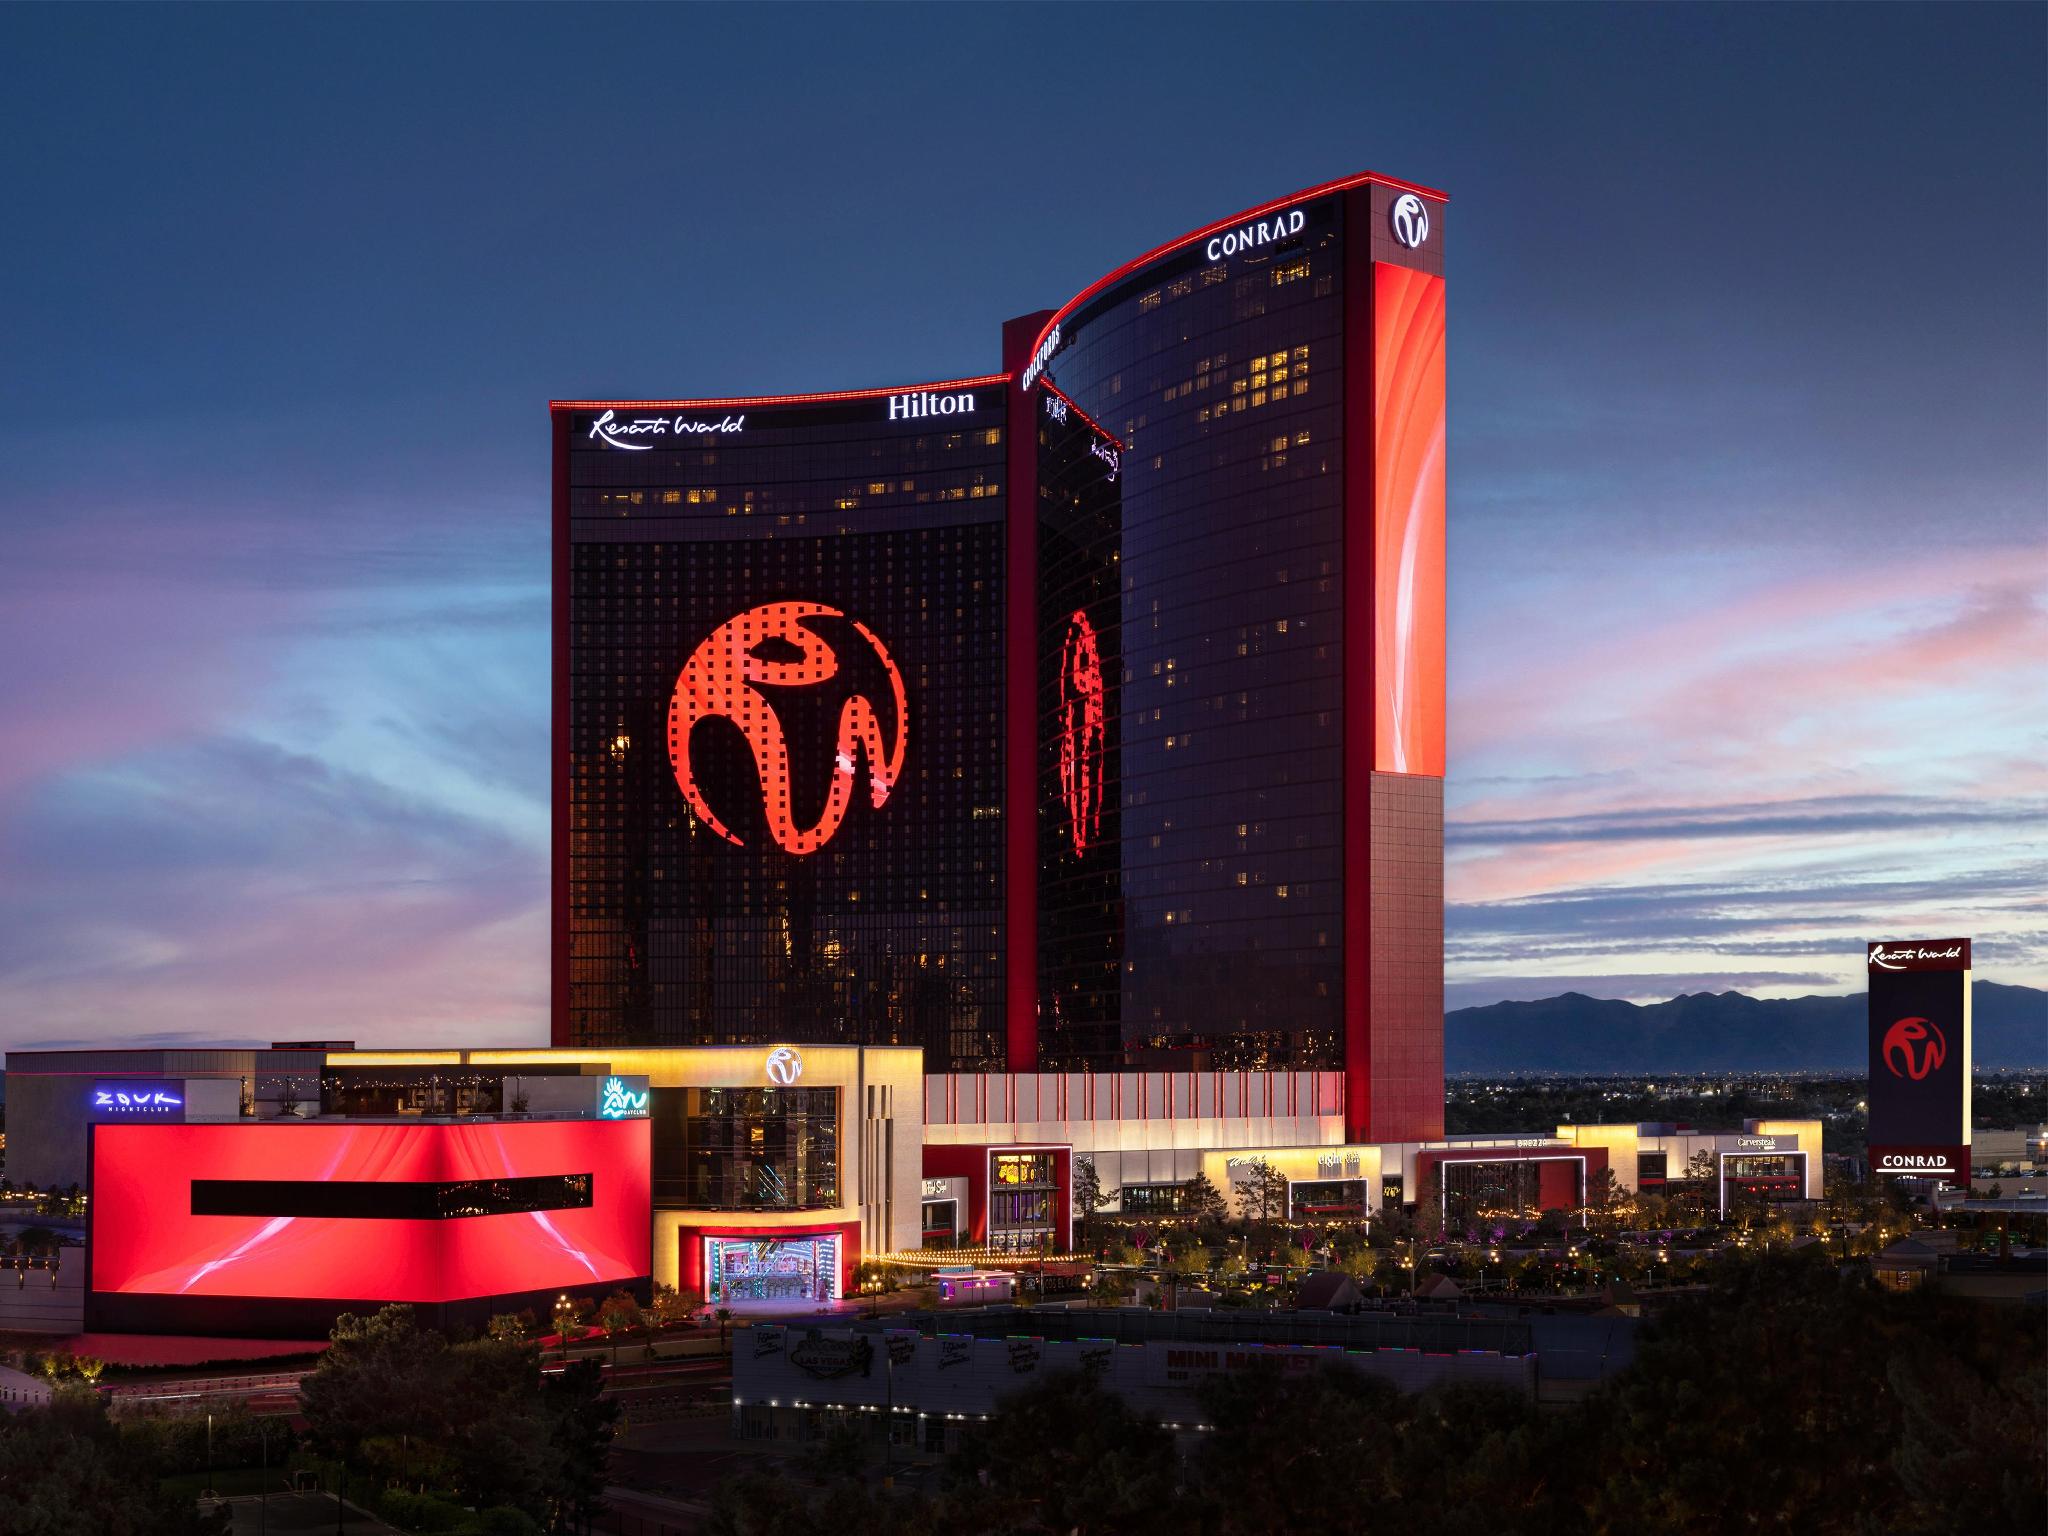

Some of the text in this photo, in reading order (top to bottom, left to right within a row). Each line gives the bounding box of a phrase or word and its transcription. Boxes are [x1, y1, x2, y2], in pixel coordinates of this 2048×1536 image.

[1207, 210, 1306, 261] CONRAD
[1022, 323, 1060, 391] CROCKFORDS
[888, 391, 975, 420] Hilton
[589, 409, 745, 450] Resorts World
[1868, 944, 1962, 970] Resorts World
[95, 1091, 182, 1106] ZOUK
[1737, 1137, 1776, 1147] Carversteak
[1882, 1155, 1947, 1167] CONRAD
[1168, 1350, 1218, 1368] MINI
